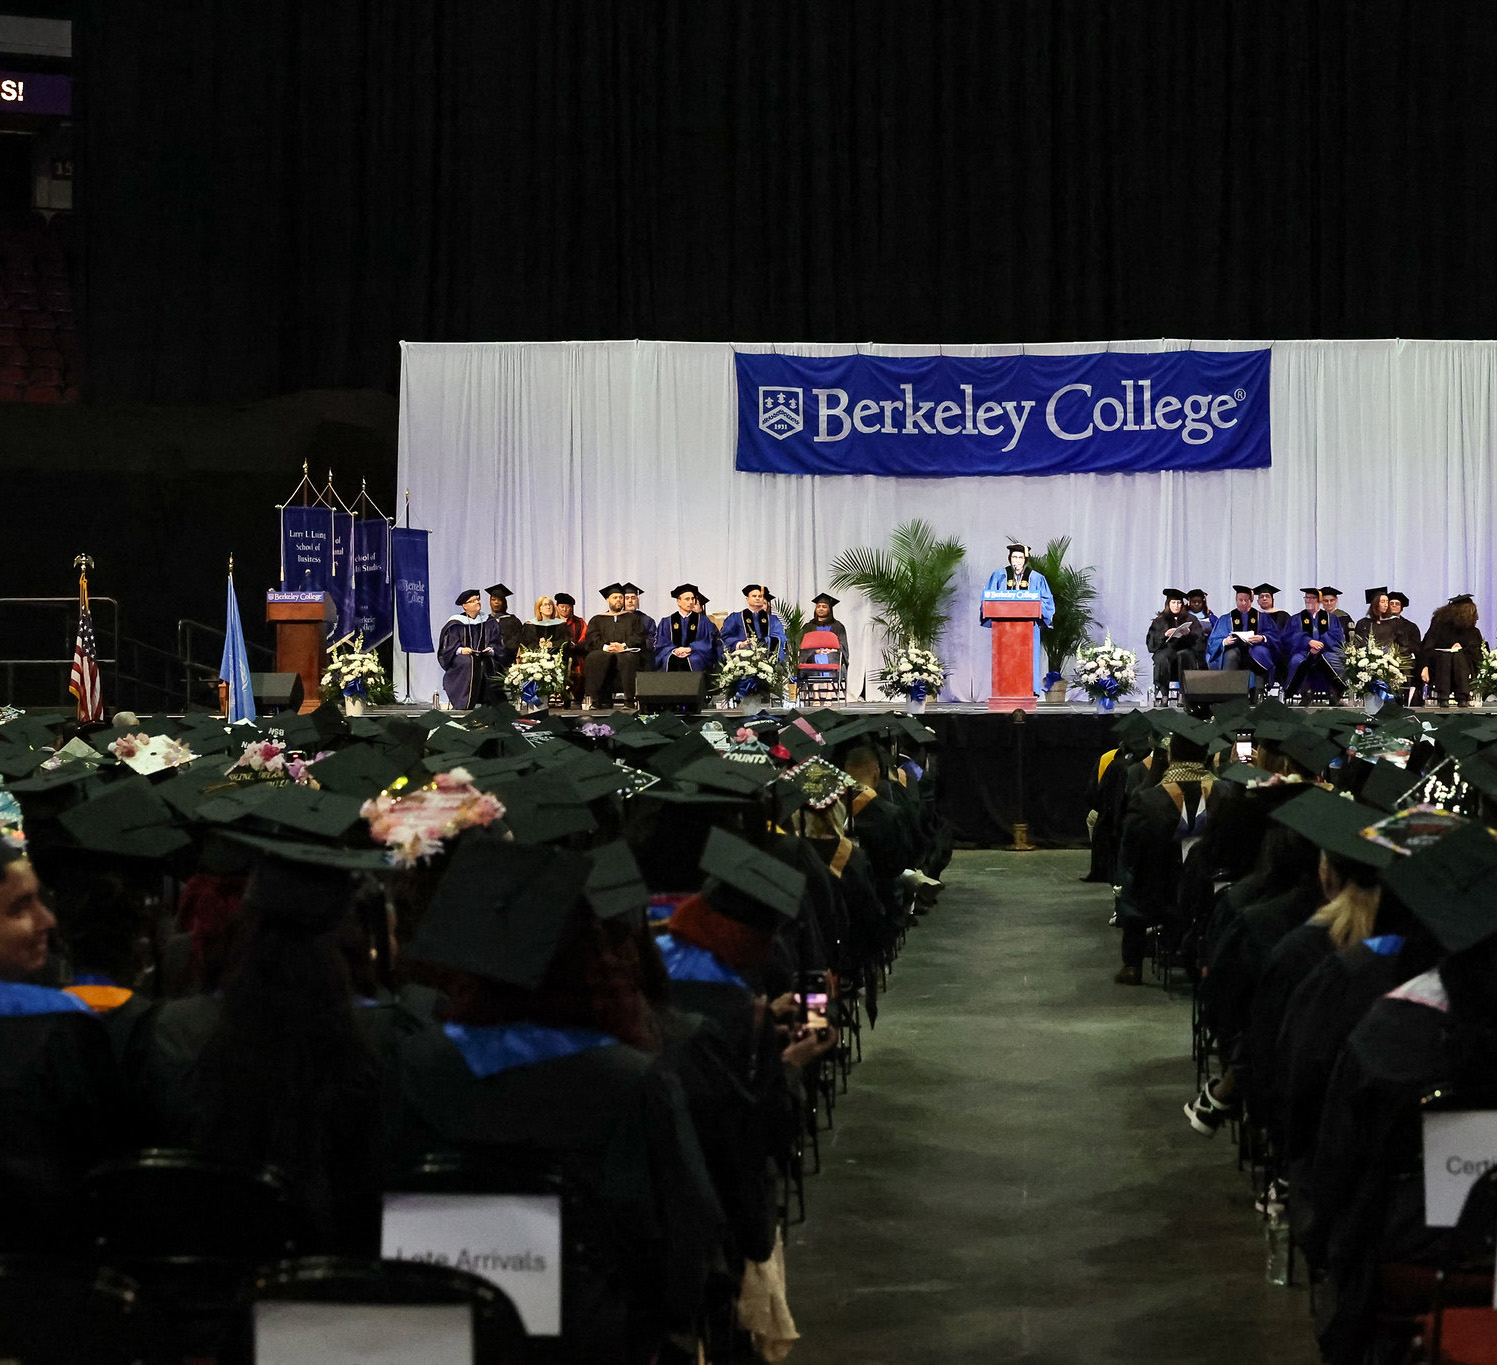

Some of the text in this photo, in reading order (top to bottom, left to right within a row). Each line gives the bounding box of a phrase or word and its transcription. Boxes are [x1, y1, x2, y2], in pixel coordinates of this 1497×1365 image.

[812, 384, 1036, 452] Berkeley
[274, 593, 323, 602] Berkeley College
[991, 591, 1039, 599] Berkeley College
[455, 1247, 548, 1272] Arrivals
